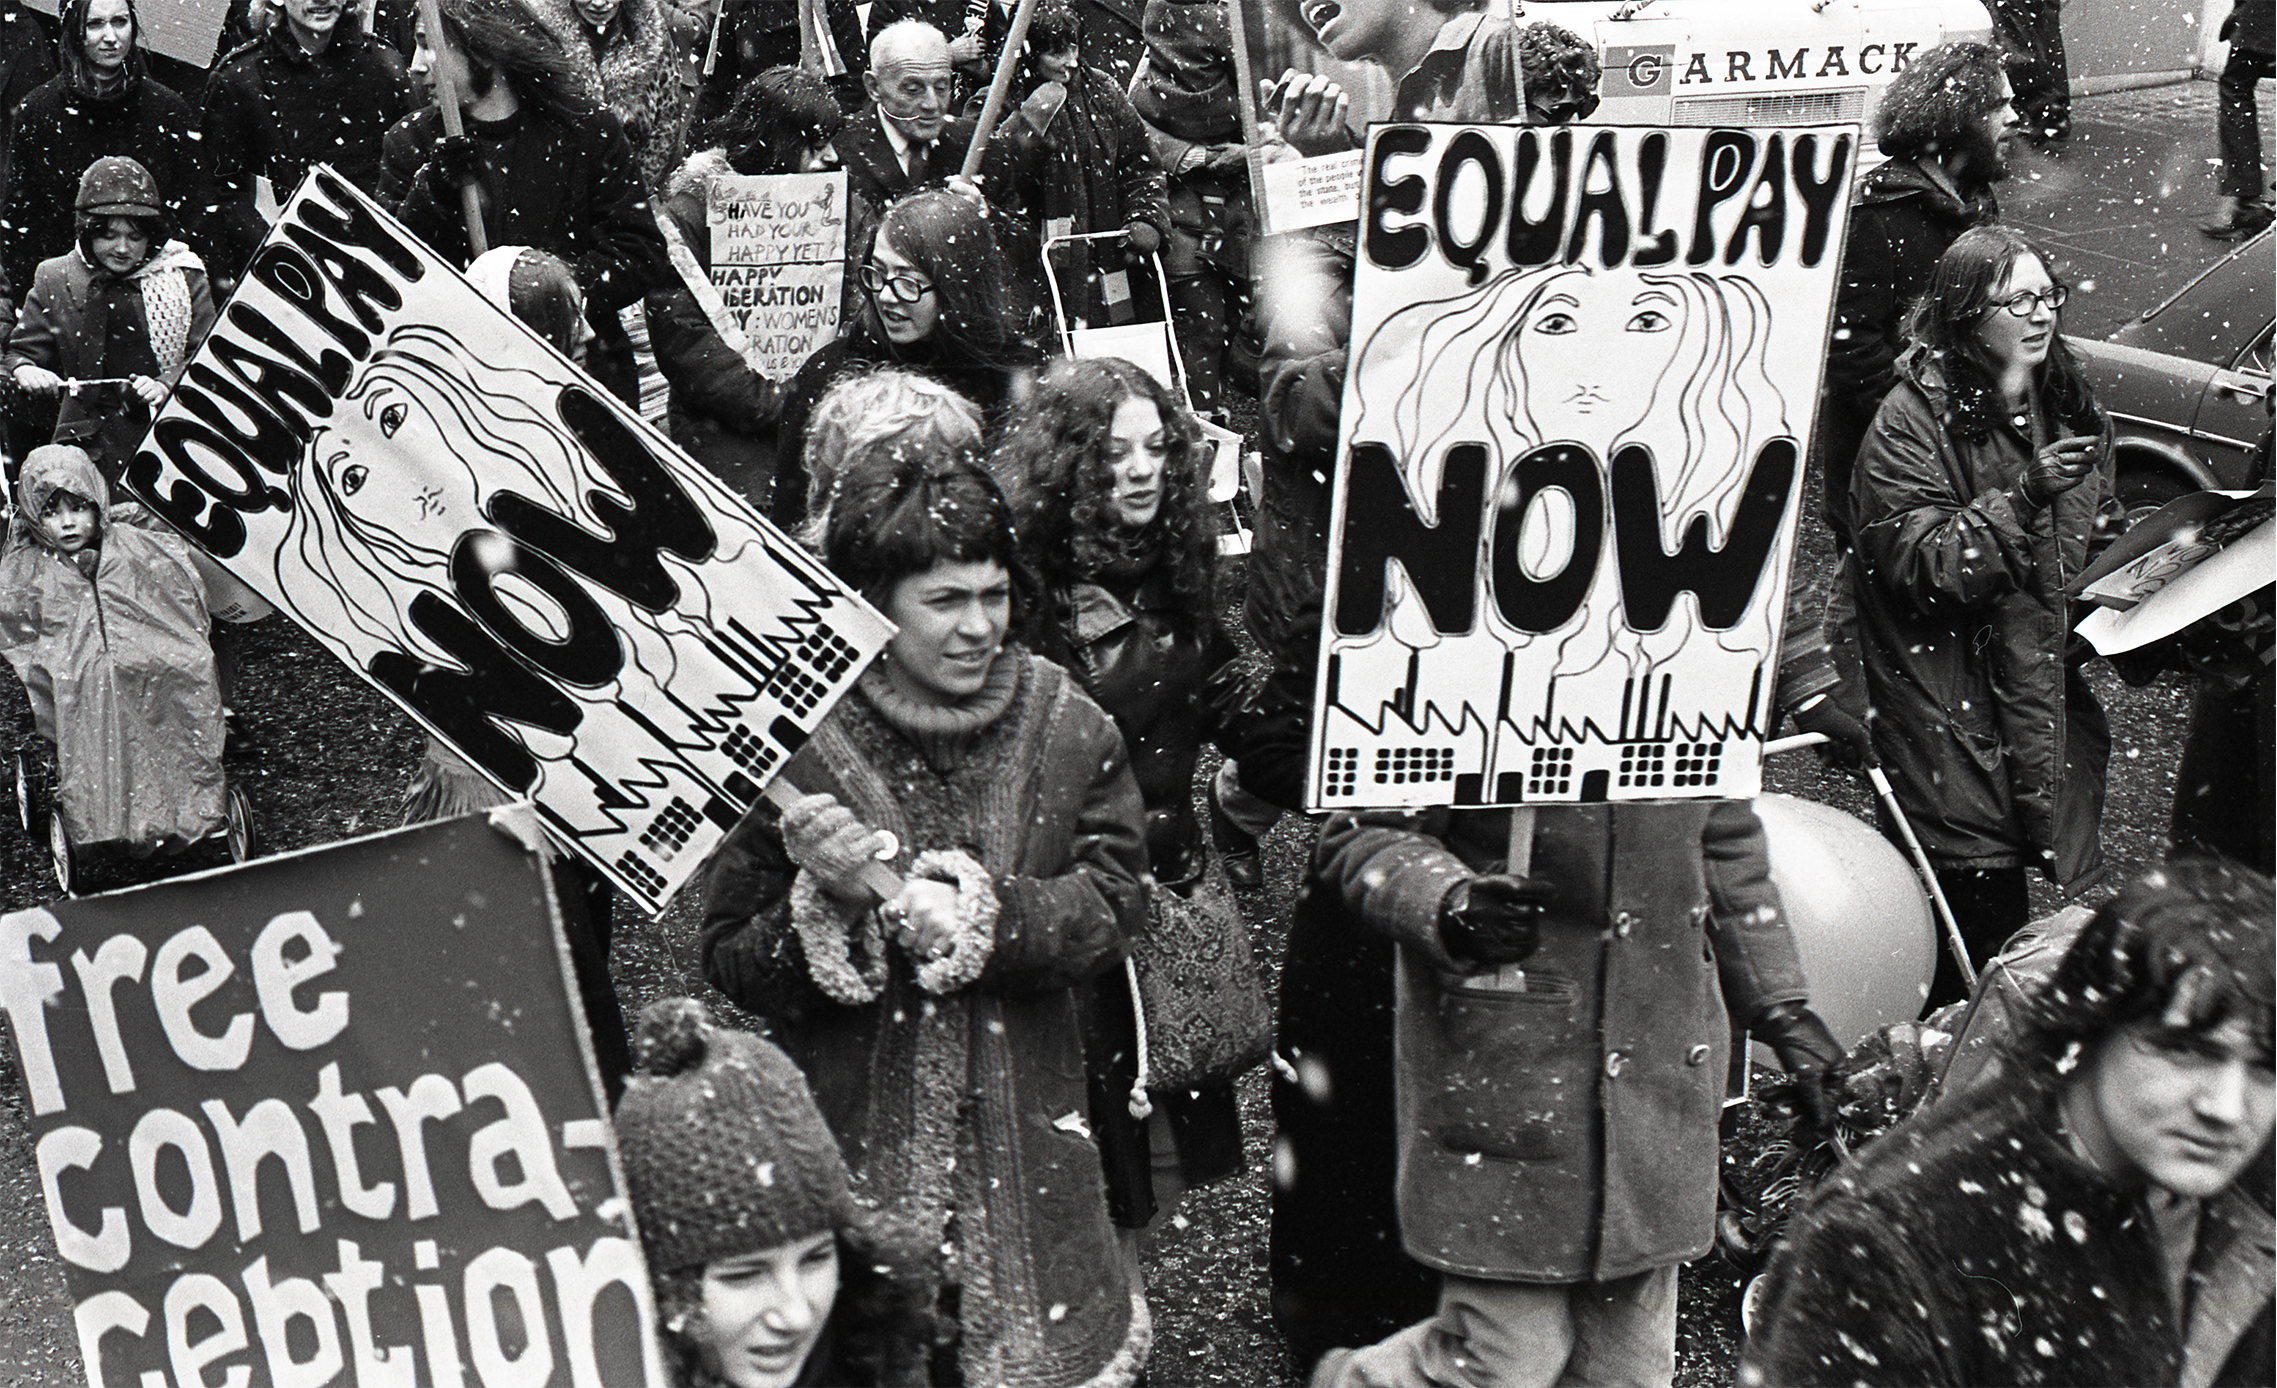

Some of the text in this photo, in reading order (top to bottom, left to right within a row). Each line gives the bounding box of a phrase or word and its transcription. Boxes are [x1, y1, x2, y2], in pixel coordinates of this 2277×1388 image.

[1627, 42, 1918, 87] GARMACK
[728, 221, 814, 239] HAD YOUR
[728, 244, 789, 261] HAPPY
[777, 201, 809, 219] YOU
[1365, 126, 1853, 287] EQUAL PAY
[723, 285, 824, 307] IBERATION
[129, 173, 426, 559] EQUAL PAY
[367, 384, 718, 793] NOW
[1331, 438, 1800, 638] NOW
[0, 906, 350, 1116] free
